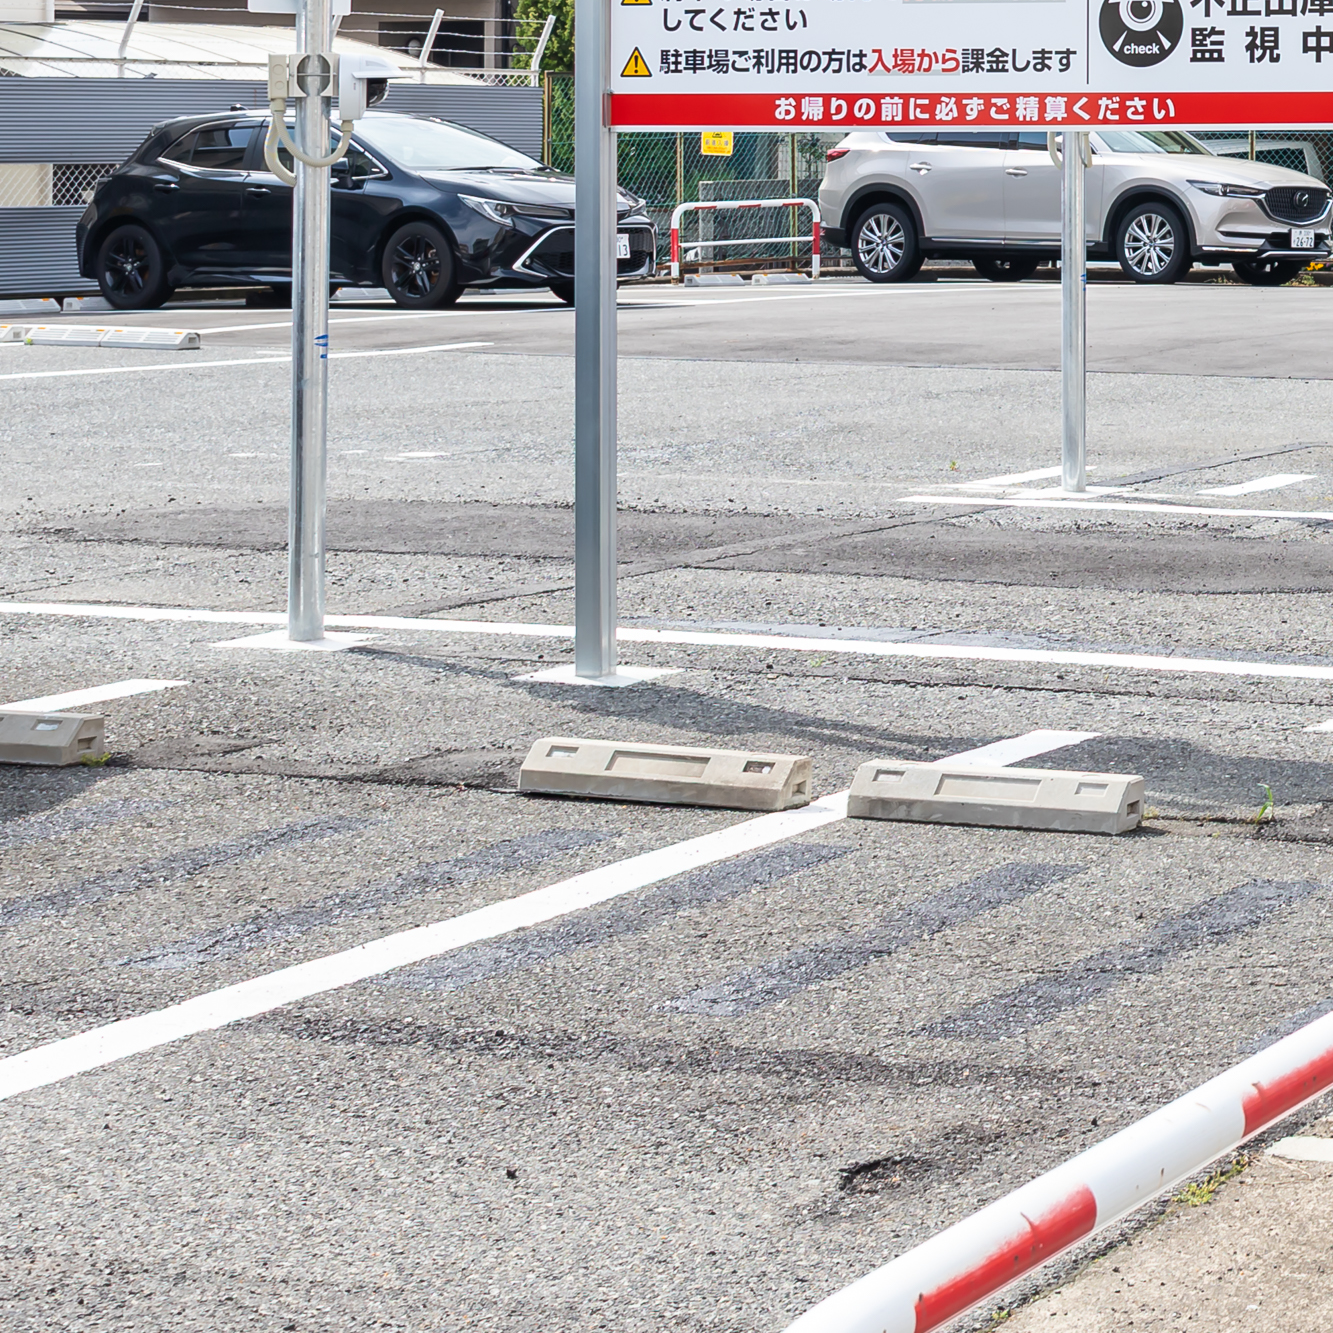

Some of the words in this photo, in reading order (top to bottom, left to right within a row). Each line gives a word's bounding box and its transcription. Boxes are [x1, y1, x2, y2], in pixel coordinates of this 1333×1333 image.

[662, 7, 808, 32] してください
[659, 47, 1078, 74] 駐車場ご利用の方は入場から課金します
[1123, 42, 1161, 55] check
[774, 96, 1176, 122] お帰りの前に必ずご精算ください
